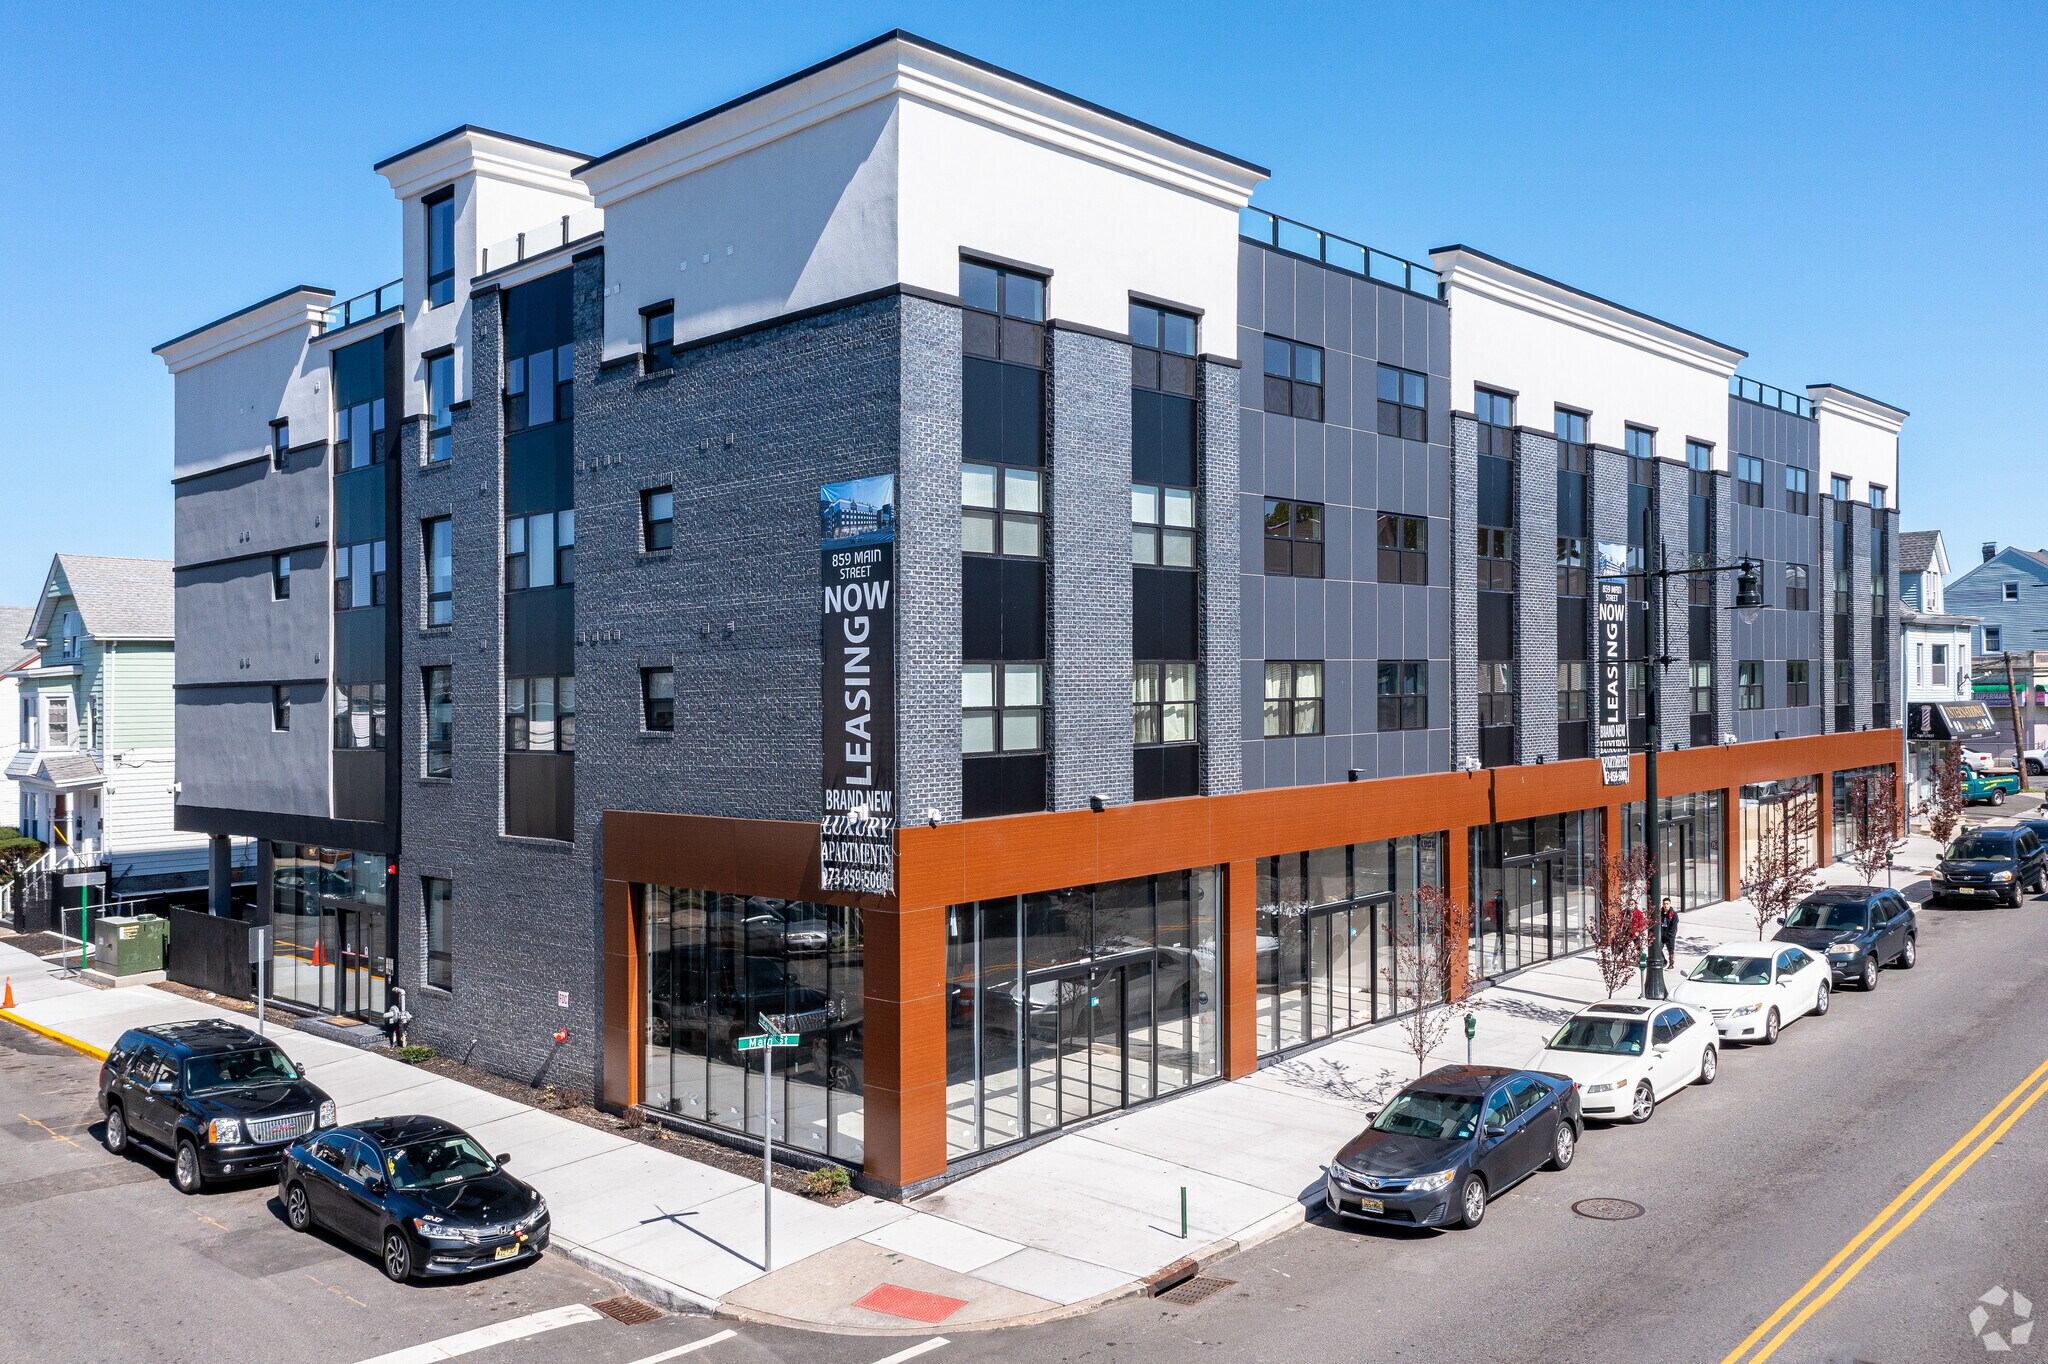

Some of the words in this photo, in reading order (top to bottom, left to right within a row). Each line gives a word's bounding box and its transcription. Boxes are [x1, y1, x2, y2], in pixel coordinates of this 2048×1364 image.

[832, 552, 851, 567] 859
[855, 549, 882, 565] MAIN
[840, 565, 871, 580] STREET
[824, 580, 889, 614] NOW
[1600, 603, 1625, 621] NOW
[1607, 623, 1619, 723] LEASING
[843, 615, 872, 786] LEASING
[826, 789, 864, 811] BRAND
[867, 790, 892, 812] NEW
[822, 815, 893, 838] LUXURY
[822, 841, 891, 866] APARTMENTS
[749, 1038, 773, 1048] Main
[780, 1036, 788, 1045] St
